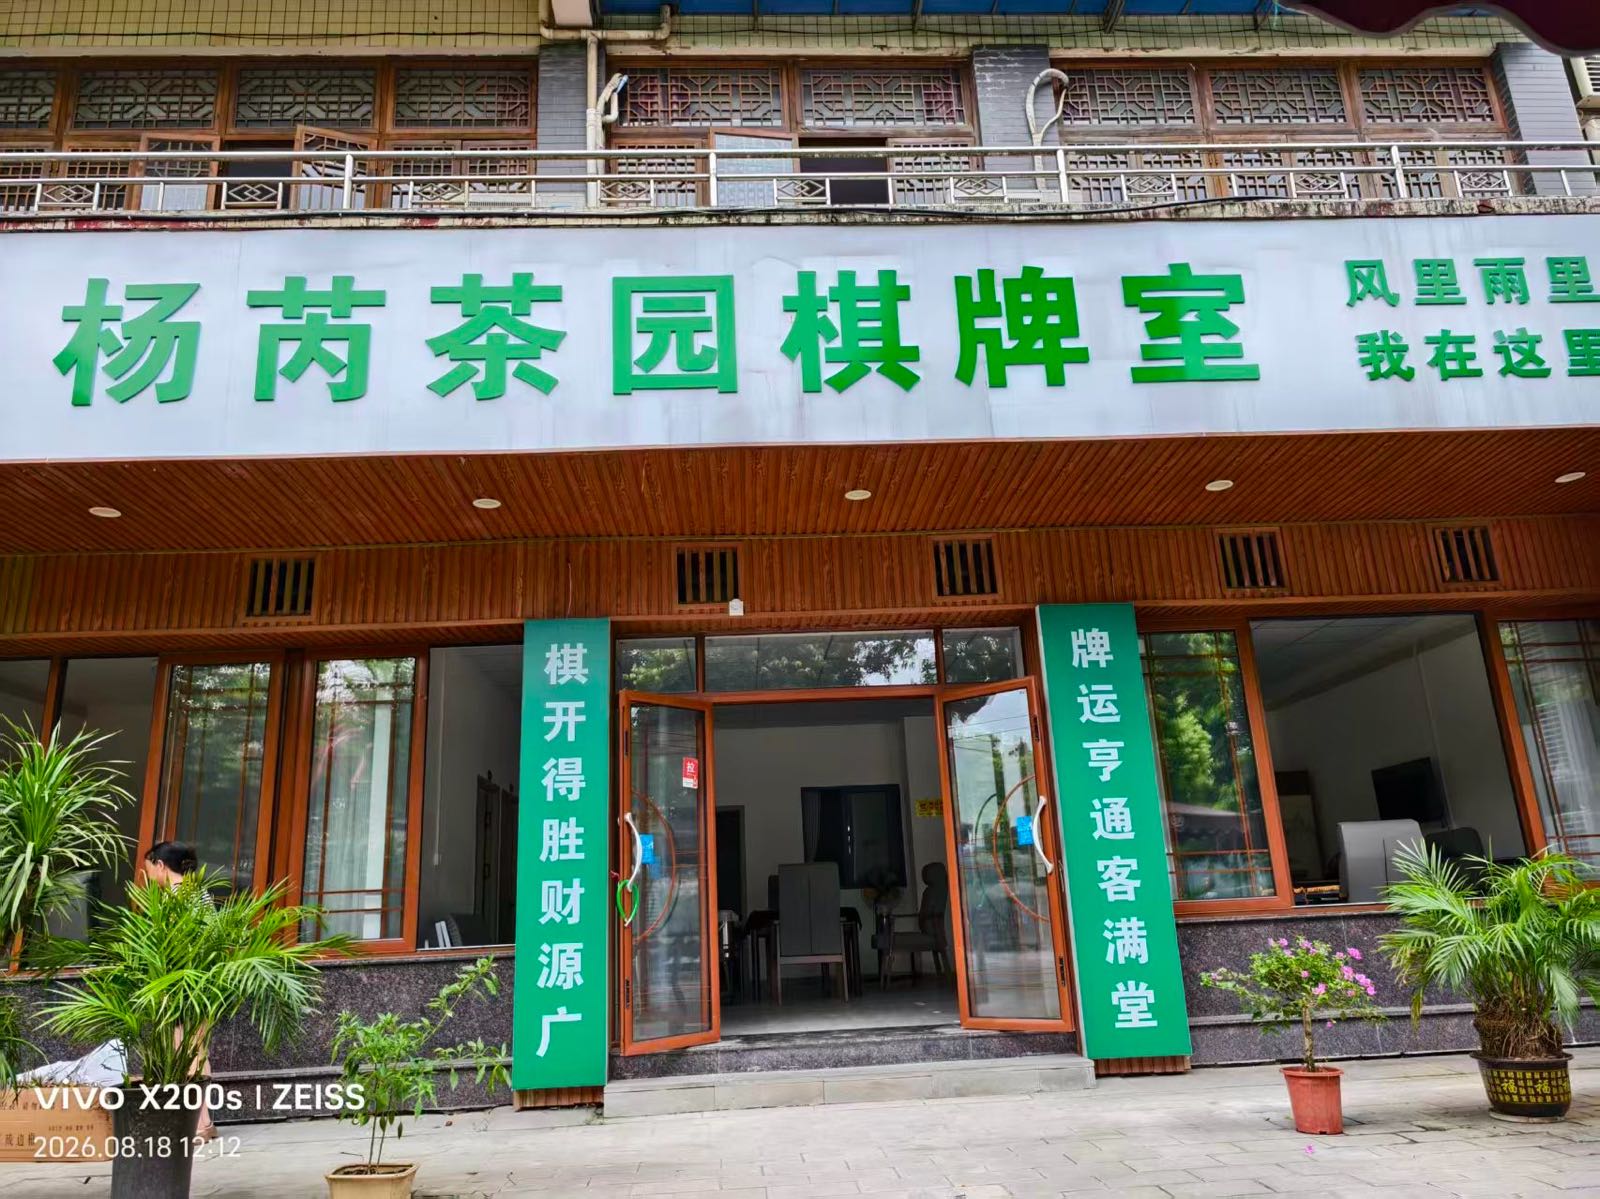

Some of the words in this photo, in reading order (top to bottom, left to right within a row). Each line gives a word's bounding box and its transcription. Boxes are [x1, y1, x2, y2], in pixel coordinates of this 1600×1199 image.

[53, 263, 1261, 406] 杨芮茶园棋牌室
[1345, 256, 1600, 307] 风里雨里
[1355, 327, 1600, 381] 我在这里
[536, 643, 589, 1057] 棋开得胜财源广
[1070, 628, 1158, 1029] 牌运亨通客满堂
